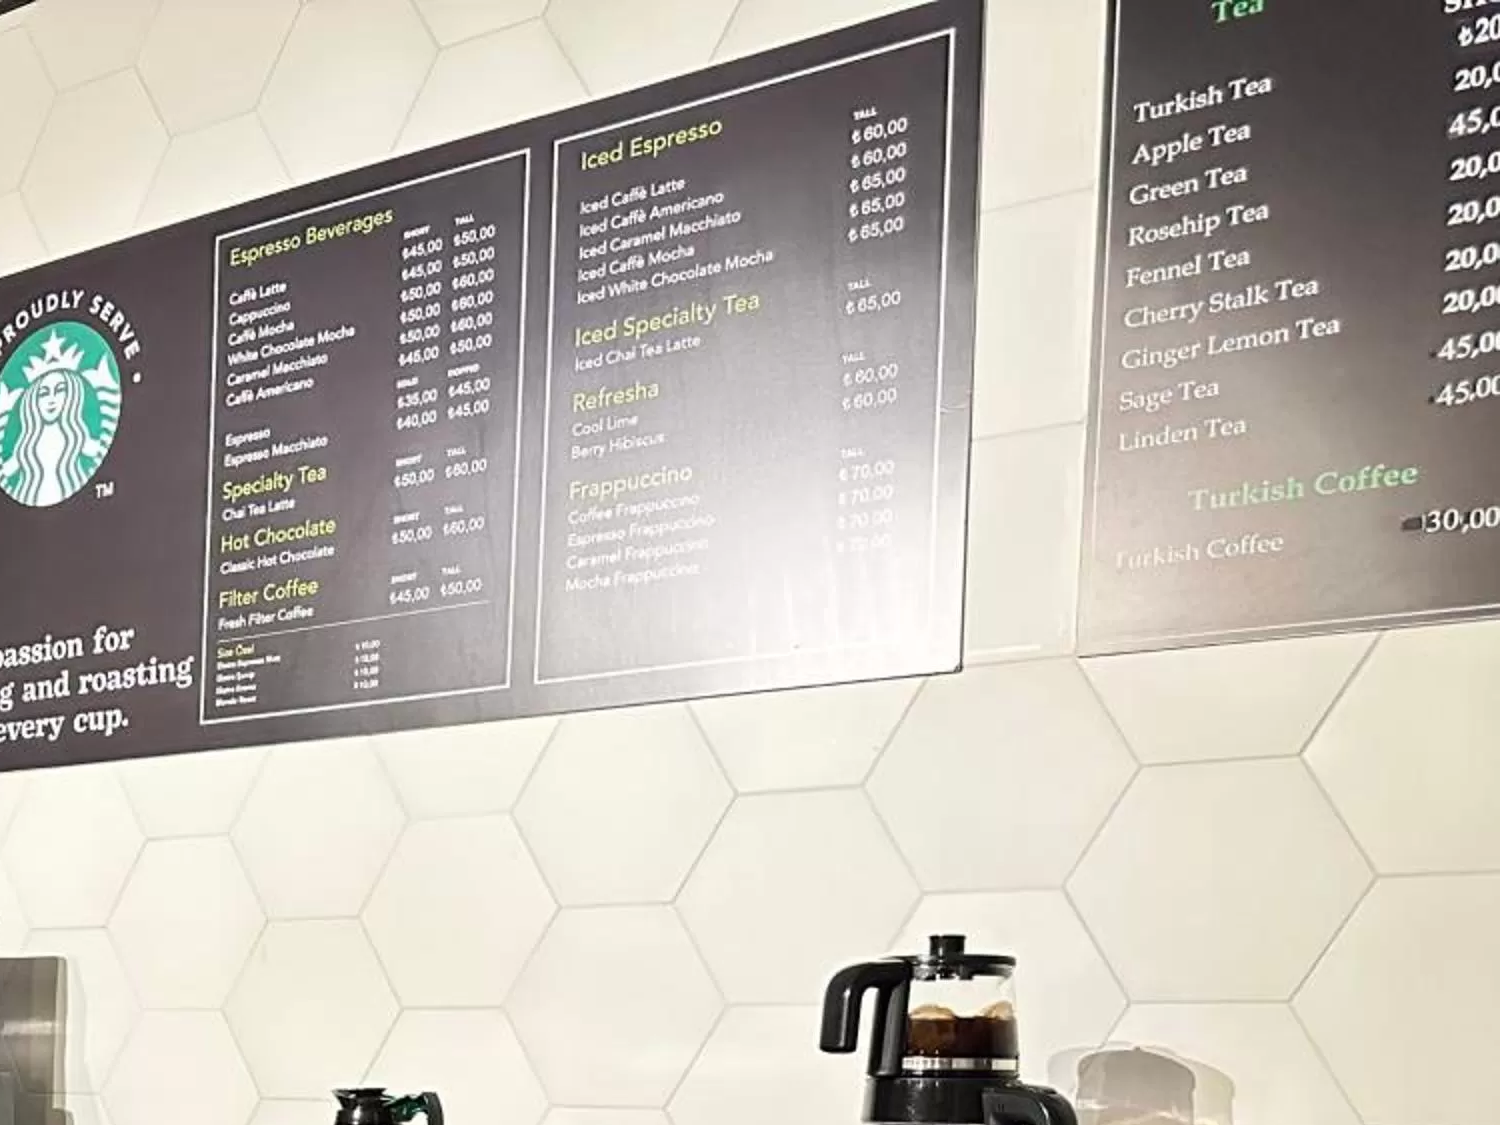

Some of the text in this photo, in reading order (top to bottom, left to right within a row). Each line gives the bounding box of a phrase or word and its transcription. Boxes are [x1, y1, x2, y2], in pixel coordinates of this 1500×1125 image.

[1212, 0, 1264, 23] Tea
[1134, 77, 1273, 123] Turkish Tea
[581, 120, 723, 170] Iced Espresso
[1132, 124, 1251, 166] Apple Tea
[579, 196, 608, 214] Iced
[651, 178, 685, 197] Latte
[1129, 167, 1248, 205] Green Tea
[579, 218, 607, 237] Iced
[649, 192, 724, 220] Americano
[1128, 203, 1269, 247] Rosehip Tea
[230, 209, 393, 266] Espresso Beverages
[579, 211, 741, 260] Iced Caramel Macchiato
[578, 264, 606, 283] Iced
[649, 245, 695, 265] Mocha
[1125, 249, 1250, 288] Fennel Tea
[1444, 242, 1500, 272] 20,0
[260, 282, 287, 297] Latte
[577, 250, 773, 304] Iced White Chocolate Mocha
[229, 301, 290, 326] Cappuccino
[1124, 279, 1319, 328] Cherry Stalk Tea
[1442, 284, 1500, 314] 20,0
[89, 294, 141, 360] SERVE
[258, 321, 294, 338] Mocha
[575, 294, 759, 348] Iced Specialty Tea
[227, 325, 355, 366] White Chocolate Mocha
[575, 336, 700, 372] Iced Chai Tea Latte
[1121, 318, 1340, 369] Ginger Lemon Tea
[227, 353, 328, 386] Caramel Macchiato
[256, 378, 314, 400] Americano
[573, 381, 659, 413] Refresha
[1119, 381, 1219, 413] Sage Tea
[225, 428, 270, 448] Espresso
[572, 415, 638, 436] Cool Lime
[1118, 418, 1246, 452] Linden Tea
[224, 436, 328, 468] Espresso Macchiato
[571, 433, 665, 459] Berry Hibiscus
[223, 466, 327, 502] Specialty Tea
[570, 466, 692, 501] Frappuccino
[1188, 463, 1419, 511] Turkish Coffee
[568, 507, 612, 524] Coffee
[221, 519, 336, 553] Hot Chocolate
[1115, 533, 1285, 570] Turkish Coffee
[257, 553, 276, 567] Hot
[280, 545, 334, 564] Chocolate
[219, 578, 319, 609] Filter Coffee
[93, 624, 135, 655] for
[22, 670, 70, 703] and
[78, 656, 195, 695] roasting
[73, 706, 129, 736] cup.
